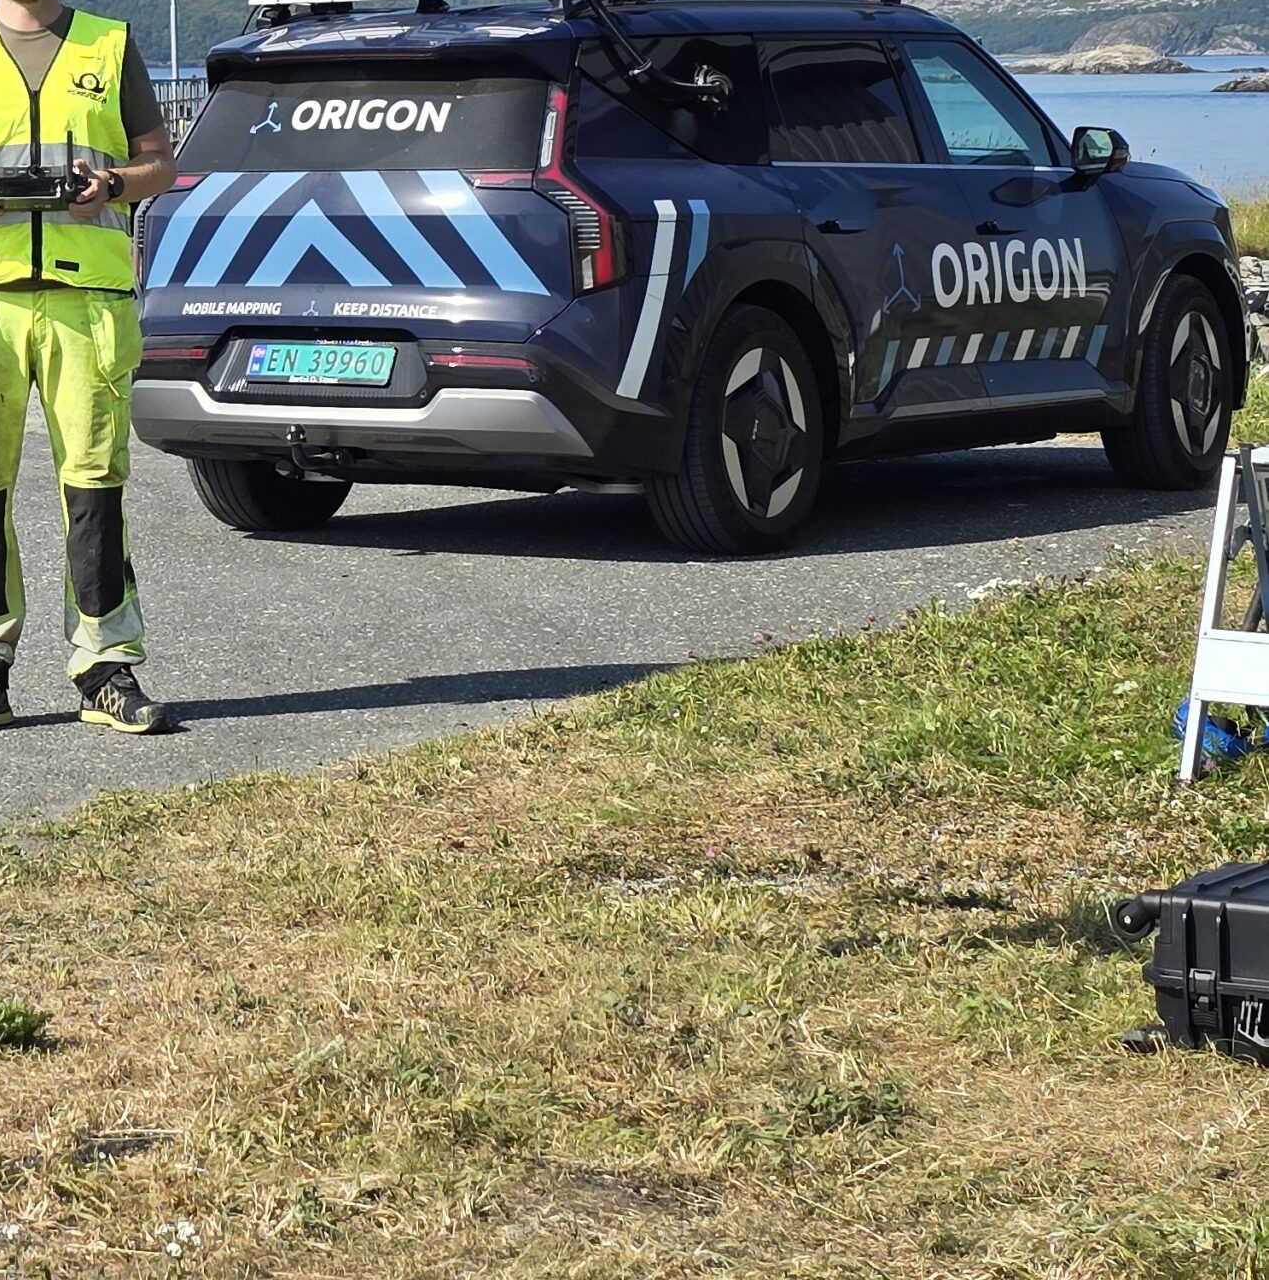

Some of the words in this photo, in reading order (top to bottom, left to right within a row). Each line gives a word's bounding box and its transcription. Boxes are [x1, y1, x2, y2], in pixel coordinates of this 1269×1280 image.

[291, 98, 452, 132] ORIGON
[931, 238, 1086, 308] ORIGON
[182, 302, 226, 315] MOBILE
[225, 302, 282, 315] MAPPING
[333, 302, 368, 316] KEEP
[369, 303, 438, 318] DISTANCE
[267, 349, 298, 372] EN
[308, 350, 385, 375] 39960
